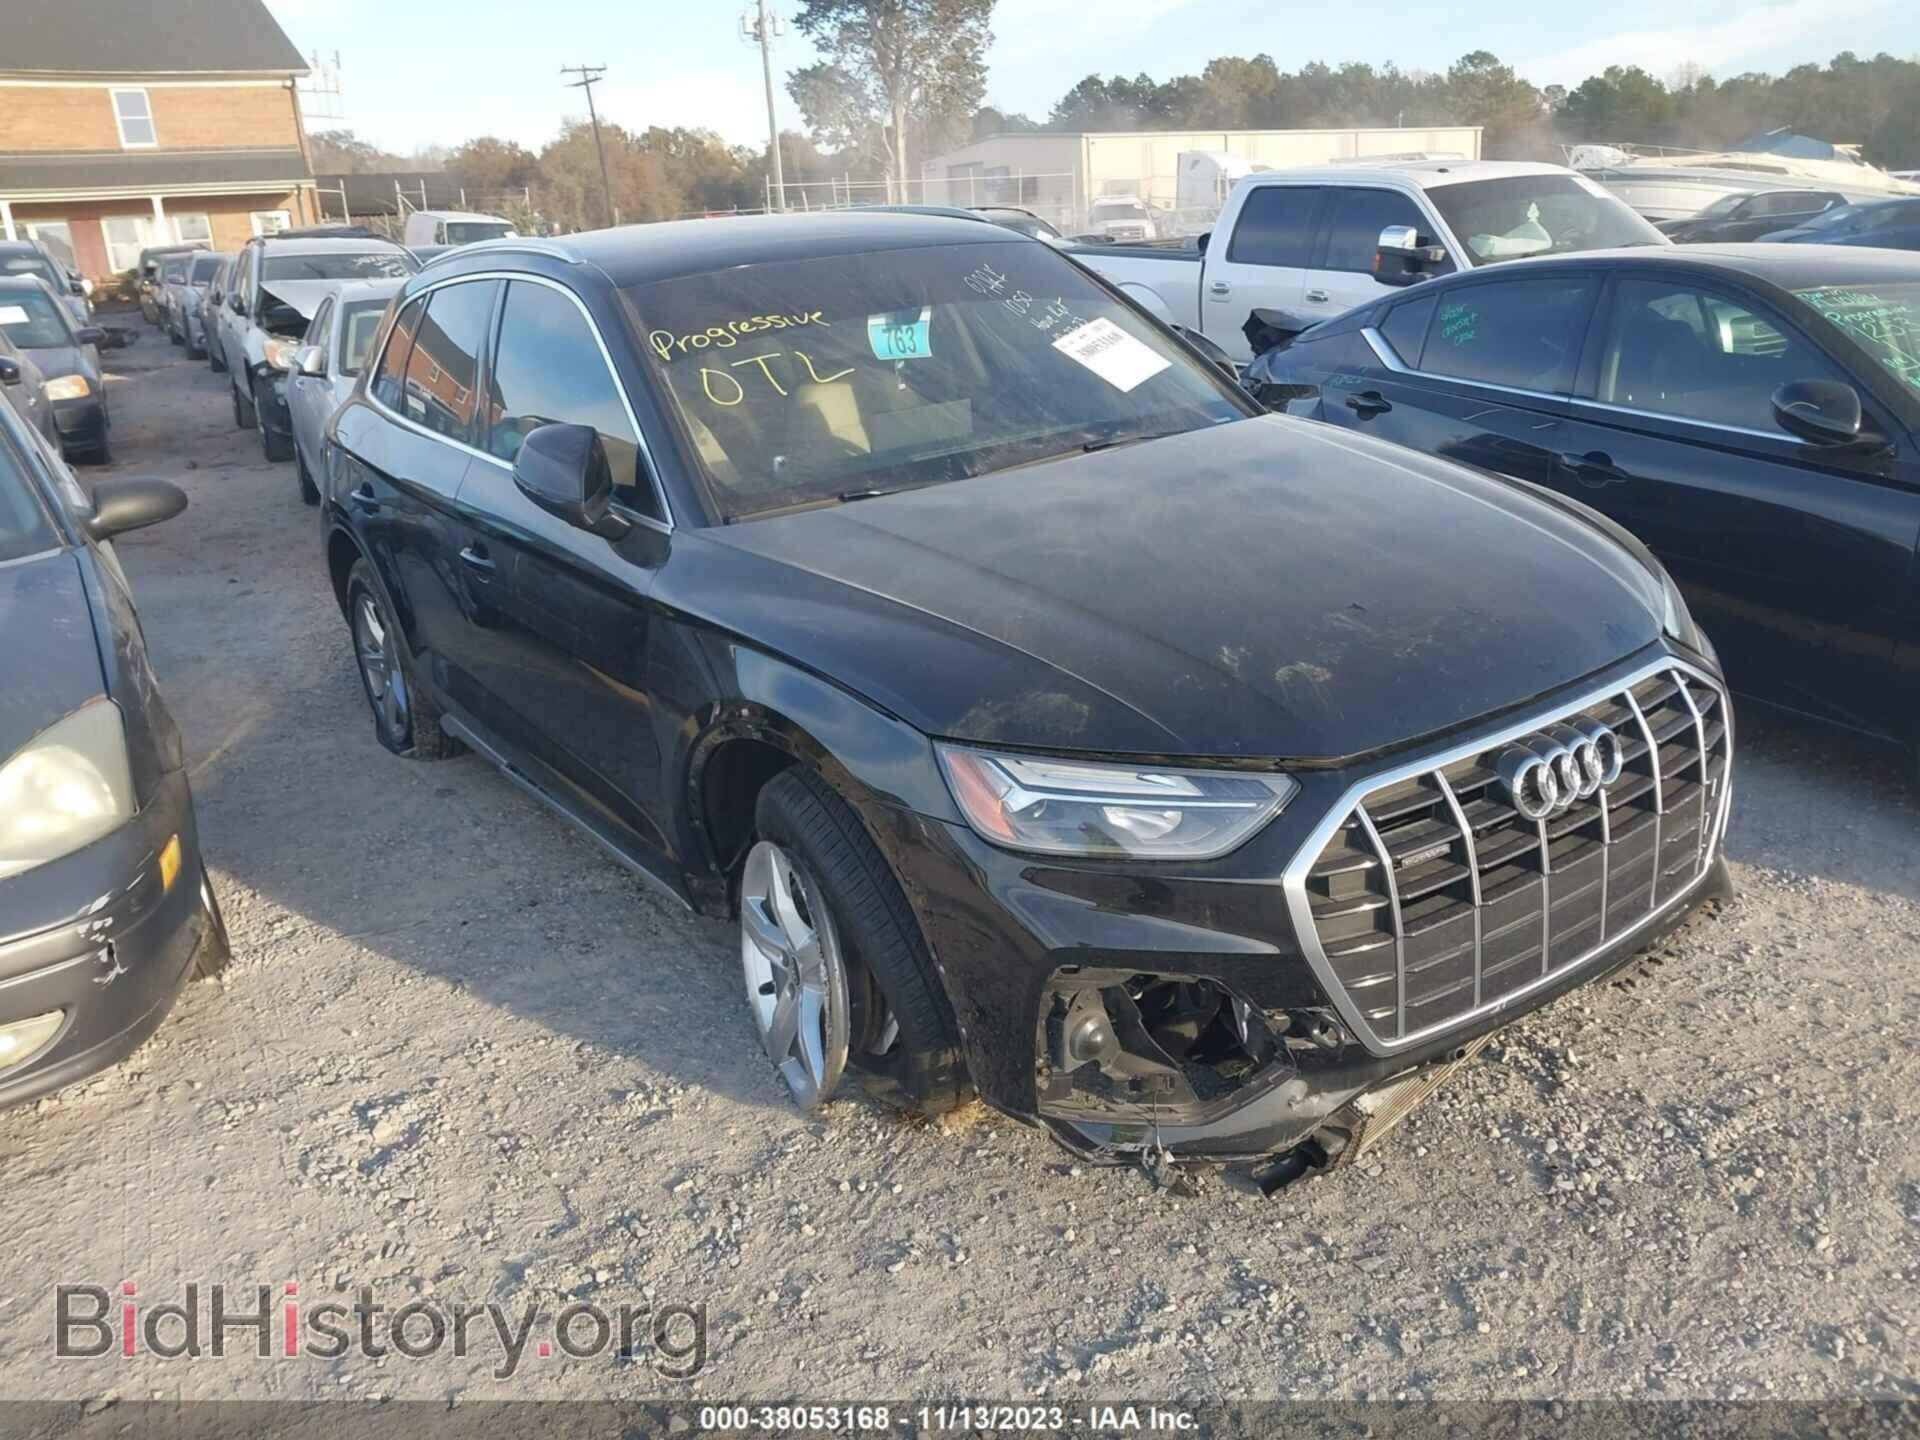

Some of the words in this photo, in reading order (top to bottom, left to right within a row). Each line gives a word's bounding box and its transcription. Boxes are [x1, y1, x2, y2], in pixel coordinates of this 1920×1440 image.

[650, 311, 831, 361] Progressive
[881, 325, 916, 355] 763
[699, 350, 856, 406] OTL
